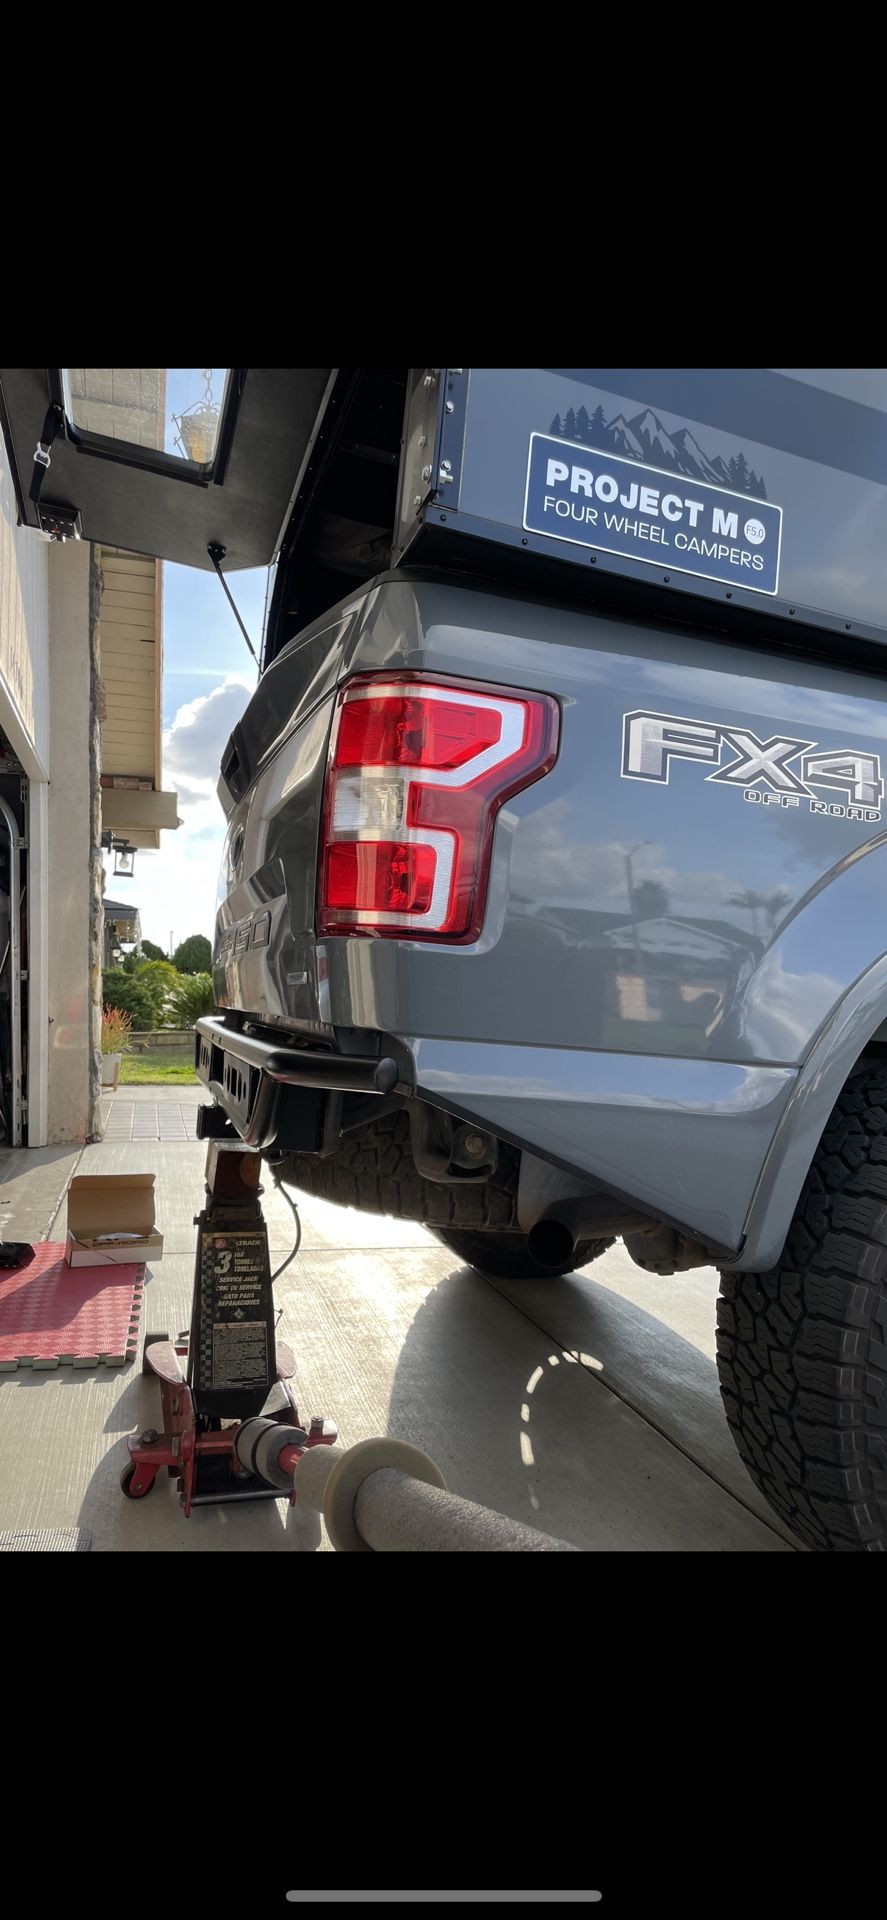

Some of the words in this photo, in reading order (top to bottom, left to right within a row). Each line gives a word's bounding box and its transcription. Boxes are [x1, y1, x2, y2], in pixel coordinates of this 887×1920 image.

[543, 496, 599, 527] FOUR
[603, 512, 670, 546] WHEEL
[674, 533, 765, 572] CAMPERS
[546, 458, 704, 528] PROJECT
[711, 508, 739, 539] M
[621, 710, 884, 810] FX4
[743, 788, 800, 808] OFF
[809, 799, 882, 823] ROAD
[214, 1251, 232, 1274] 3
